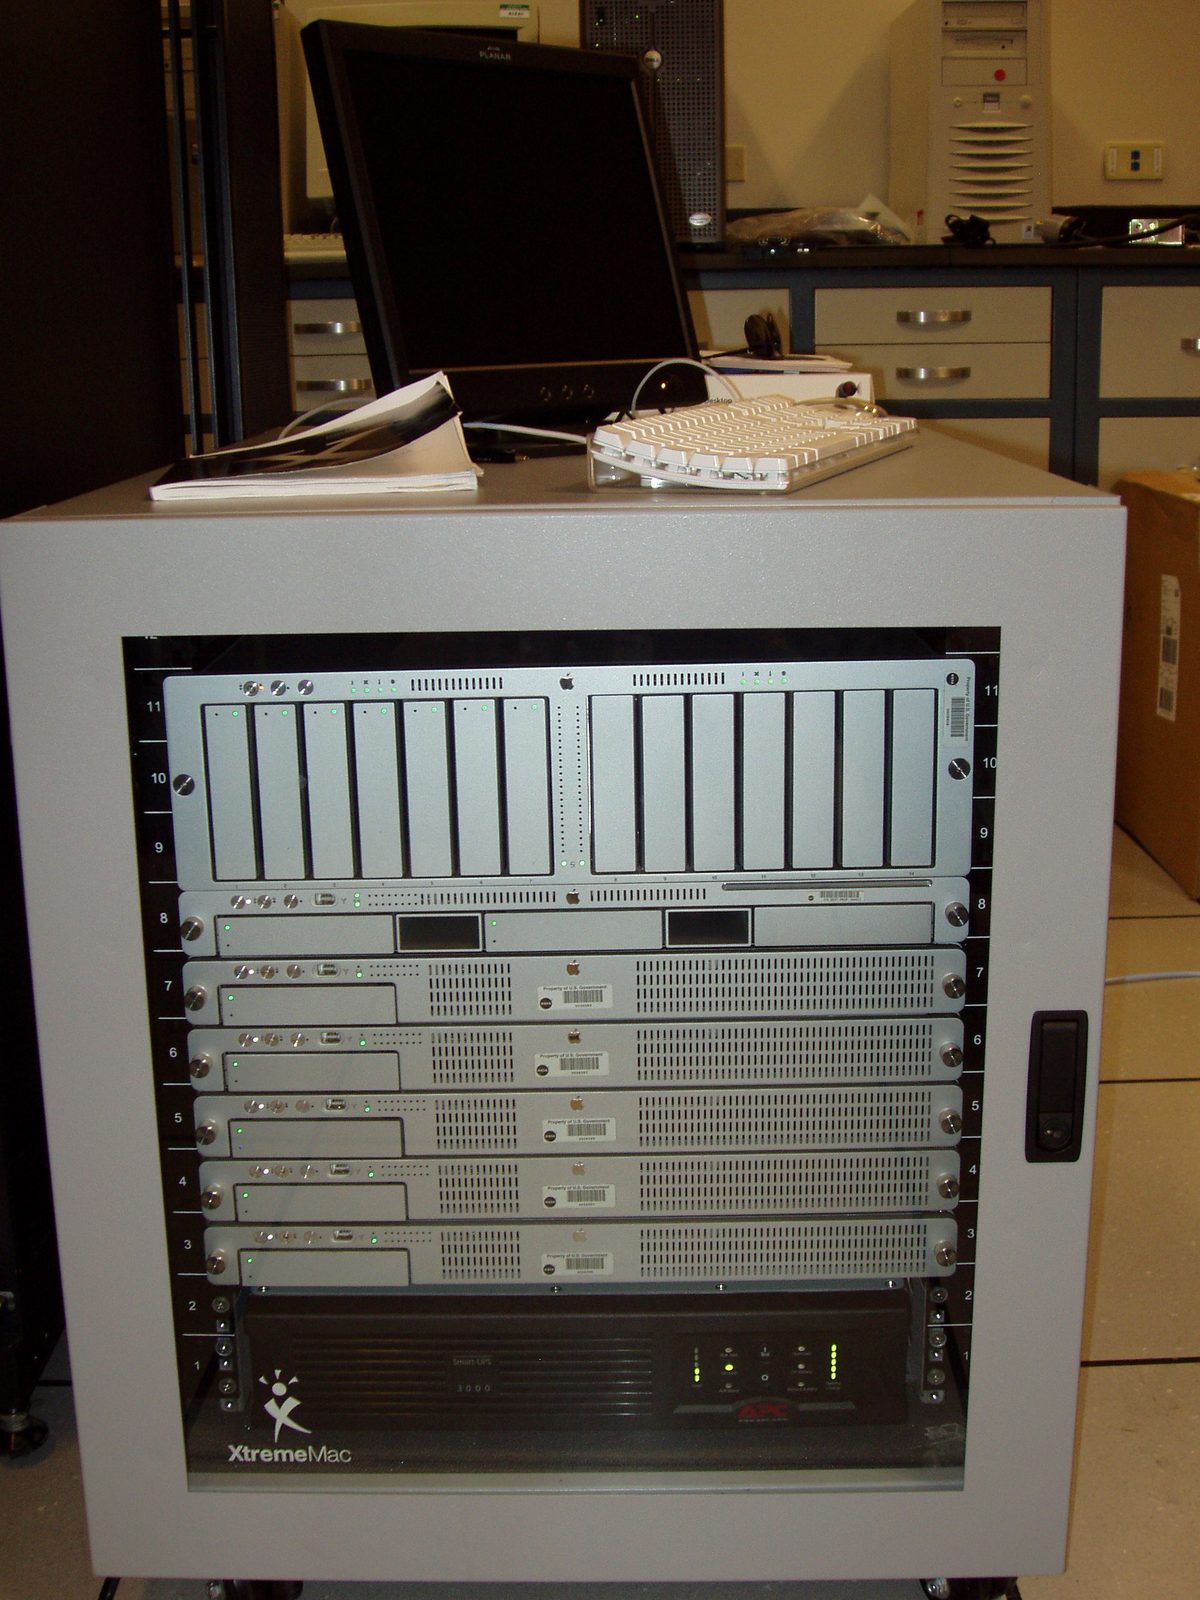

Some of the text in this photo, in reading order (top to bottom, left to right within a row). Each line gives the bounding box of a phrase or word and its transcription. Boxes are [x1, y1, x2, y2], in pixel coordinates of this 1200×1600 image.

[984, 684, 999, 697] 11
[147, 701, 160, 712] 11
[983, 757, 997, 769] 10
[151, 772, 167, 784] 10
[980, 828, 988, 838] 9
[155, 842, 164, 853] 9
[977, 899, 986, 909] 8
[160, 913, 169, 924] 8
[976, 967, 984, 977] 7
[165, 981, 173, 991] 7
[974, 1034, 982, 1045] 6
[170, 1047, 177, 1058] 6
[971, 1100, 979, 1111] 5
[175, 1112, 182, 1122] 5
[969, 1165, 977, 1174] 4
[179, 1176, 187, 1186] 4
[967, 1229, 975, 1238] 3
[184, 1239, 191, 1249] 3
[964, 1290, 973, 1300] 2
[188, 1301, 195, 1310] 2
[227, 1444, 352, 1464] XtremeMac
